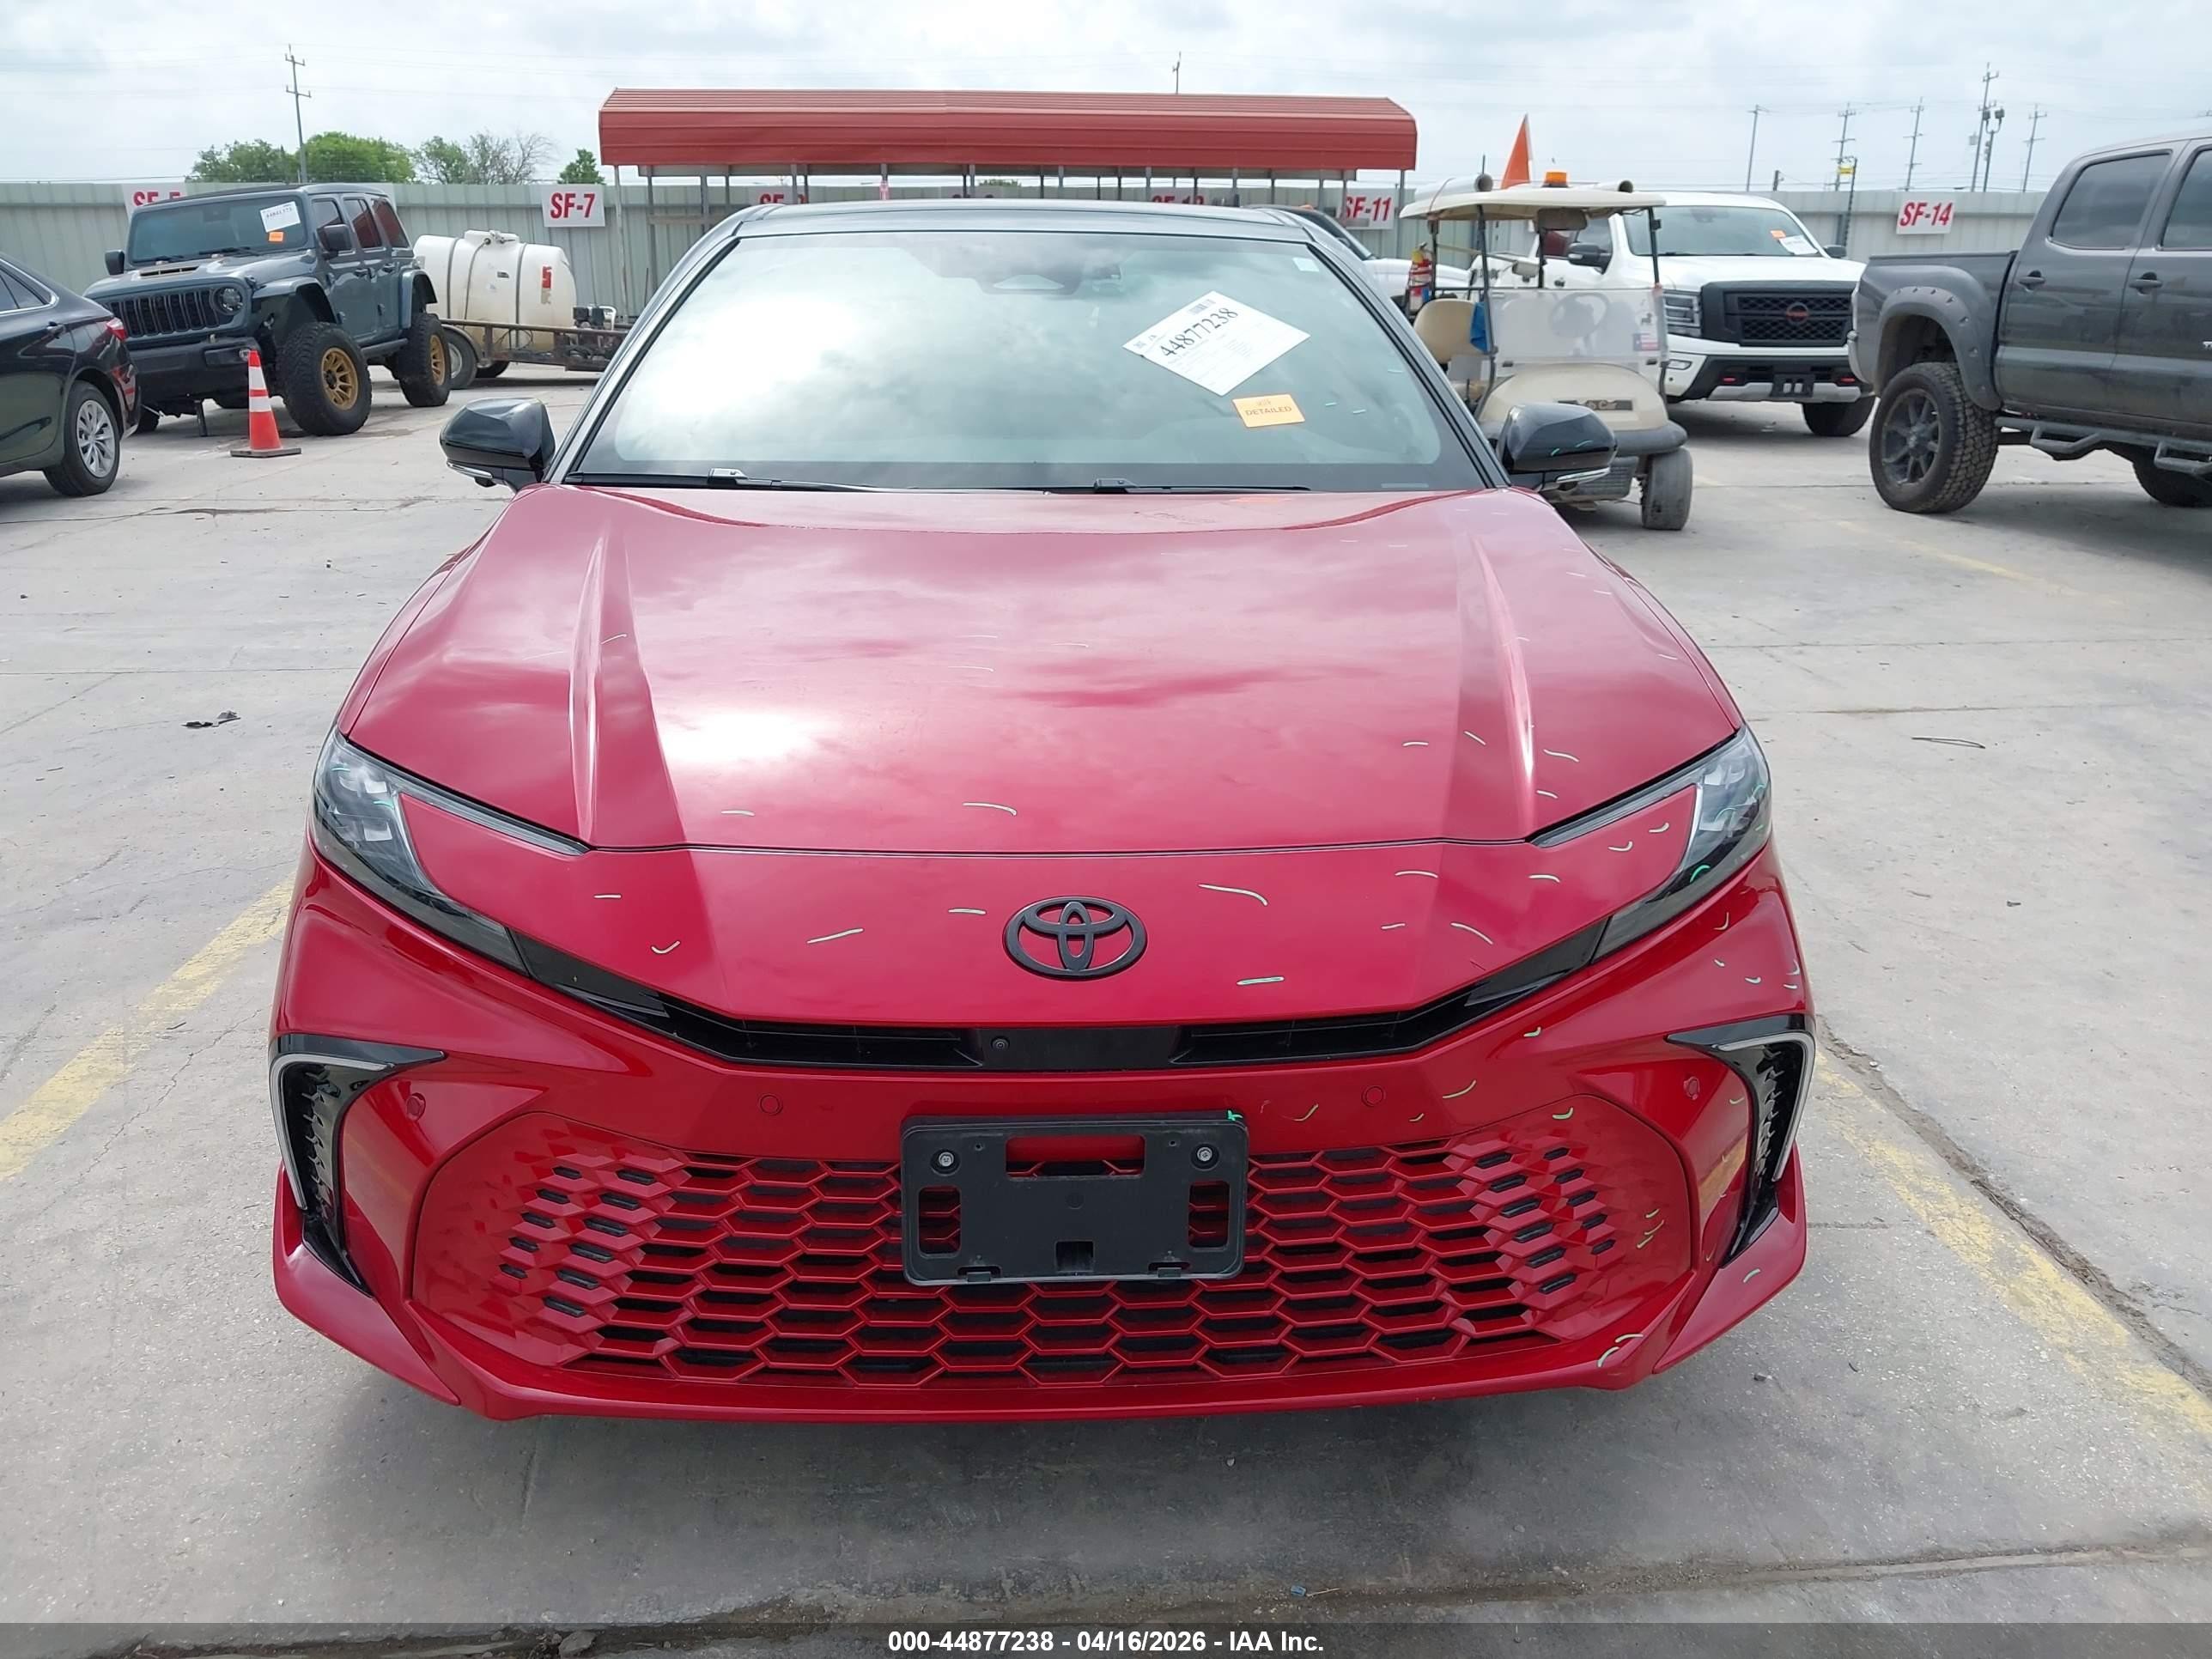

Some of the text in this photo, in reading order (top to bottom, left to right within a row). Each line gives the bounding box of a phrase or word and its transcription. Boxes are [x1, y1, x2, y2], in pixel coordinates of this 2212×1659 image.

[550, 191, 596, 219] SF-7
[1899, 202, 1953, 227] SF-14
[1160, 307, 1238, 356] 44877238
[1244, 405, 1292, 416] DETAILED
